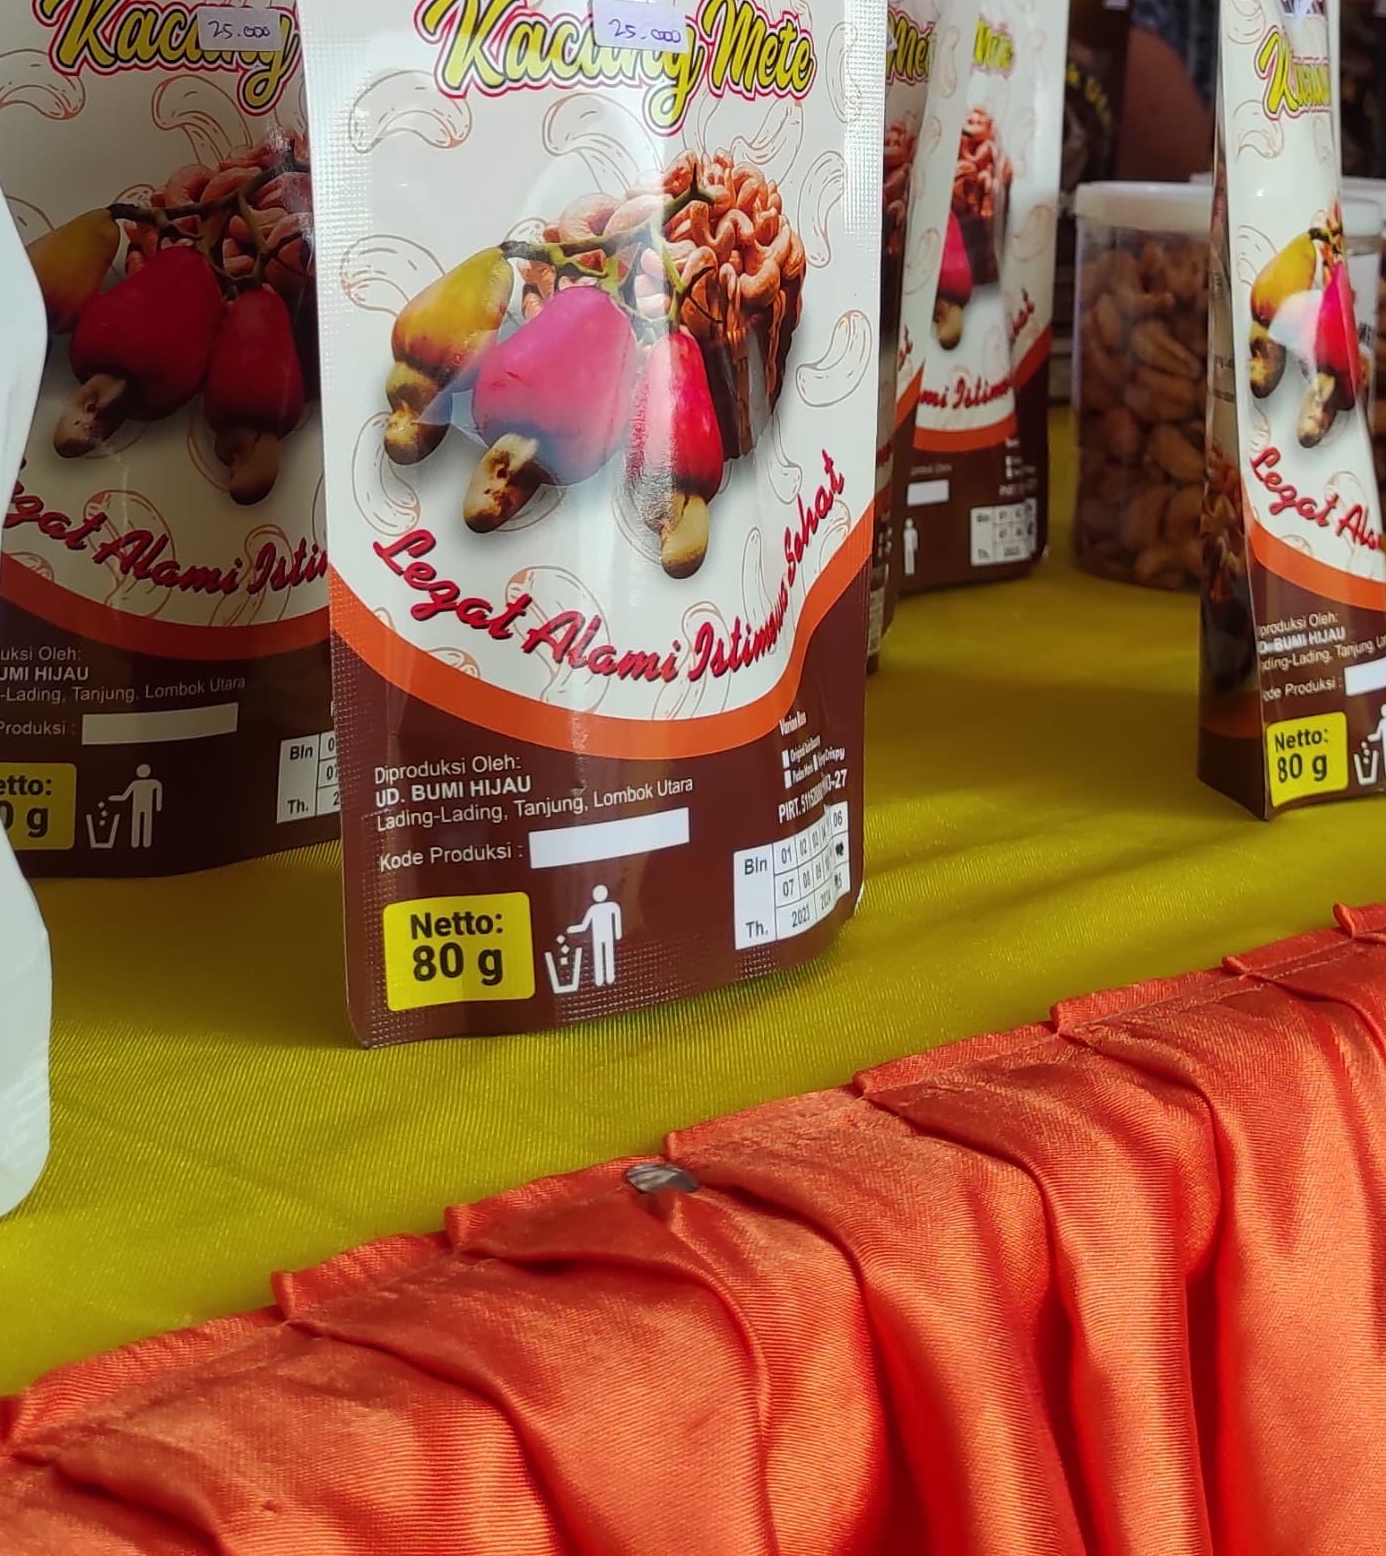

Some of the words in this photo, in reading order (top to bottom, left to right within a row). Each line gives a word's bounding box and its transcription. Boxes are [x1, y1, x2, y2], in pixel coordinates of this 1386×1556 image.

[609, 19, 683, 45] 25.000
[93, 528, 241, 596] Alami
[522, 610, 681, 683] Alami
[784, 448, 845, 589] Sehat
[1308, 611, 1340, 627] Oleh:
[37, 645, 82, 662] Oleh:
[1273, 633, 1307, 652] BUMI
[1308, 625, 1347, 645] HIJAU
[34, 665, 90, 682] HIJAU
[1284, 676, 1336, 696] Produksi
[71, 686, 139, 705] Tanjung,
[144, 681, 205, 700] Lombok
[209, 675, 247, 692] Utara
[289, 744, 314, 761] Bln
[1273, 726, 1329, 752] Netto:
[375, 755, 467, 786] Diproduksi
[471, 754, 521, 774] Oleh:
[1276, 752, 1304, 784] 80
[1310, 754, 1329, 783] g
[287, 798, 310, 815] Th.
[375, 787, 406, 809] UD.
[411, 779, 465, 804] BUMI
[470, 774, 533, 796] HIJAU
[376, 804, 509, 833] Lading-Lading,
[514, 792, 589, 820] Tanjung,
[593, 781, 654, 810] Lombok
[657, 776, 694, 796] Utara
[25, 805, 50, 839] g
[379, 848, 426, 874] Kode
[429, 841, 515, 865] Produksi
[744, 858, 769, 876] Bln
[781, 847, 793, 865] 01
[832, 811, 843, 827] 06
[782, 879, 795, 897] 07
[409, 910, 505, 942] Netto:
[745, 921, 769, 940] Th.
[412, 942, 465, 984] 80
[477, 949, 504, 987] g
